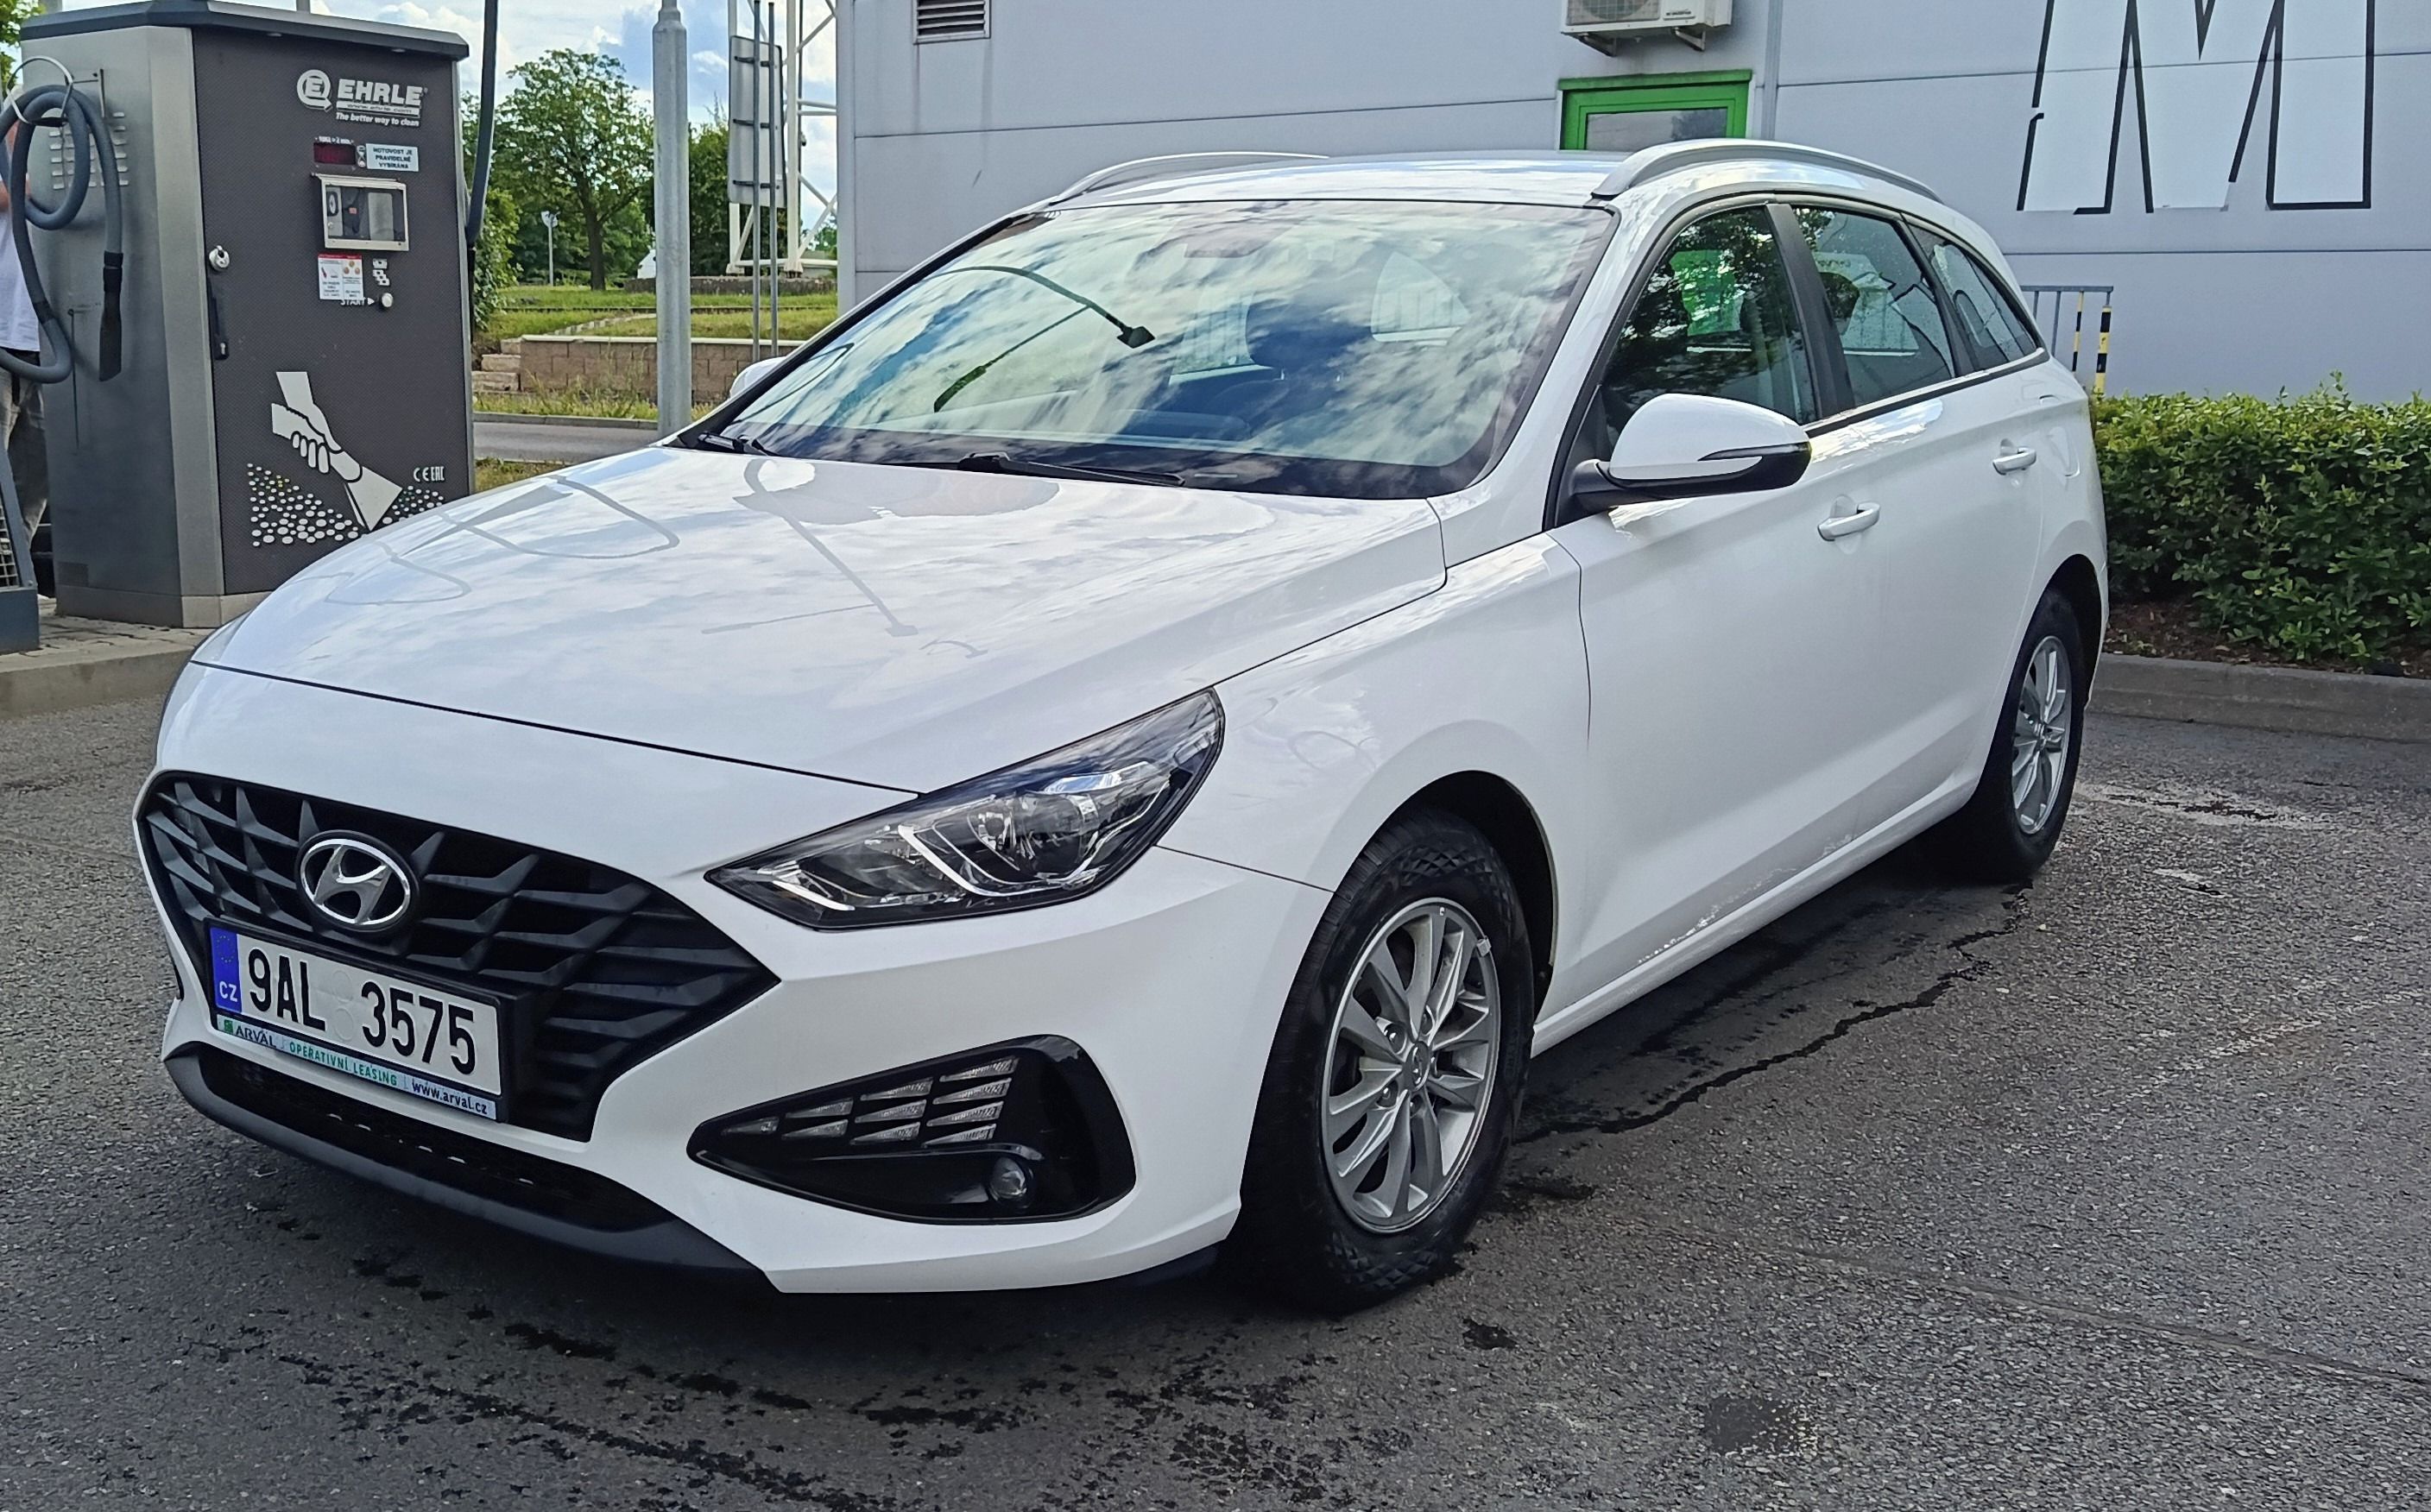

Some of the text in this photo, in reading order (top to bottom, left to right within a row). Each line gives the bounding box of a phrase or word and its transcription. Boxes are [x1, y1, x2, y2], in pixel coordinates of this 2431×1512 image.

[338, 79, 423, 105] EHRLE
[336, 112, 350, 121] The
[350, 113, 374, 123] better
[375, 117, 390, 126] way
[401, 118, 420, 127] clean
[219, 980, 238, 1003] CZ
[248, 948, 476, 1075] 9AL 3575
[236, 1025, 277, 1048] ARVAL
[353, 1062, 398, 1087] LEASING
[412, 1080, 488, 1115] www.arval.cz
